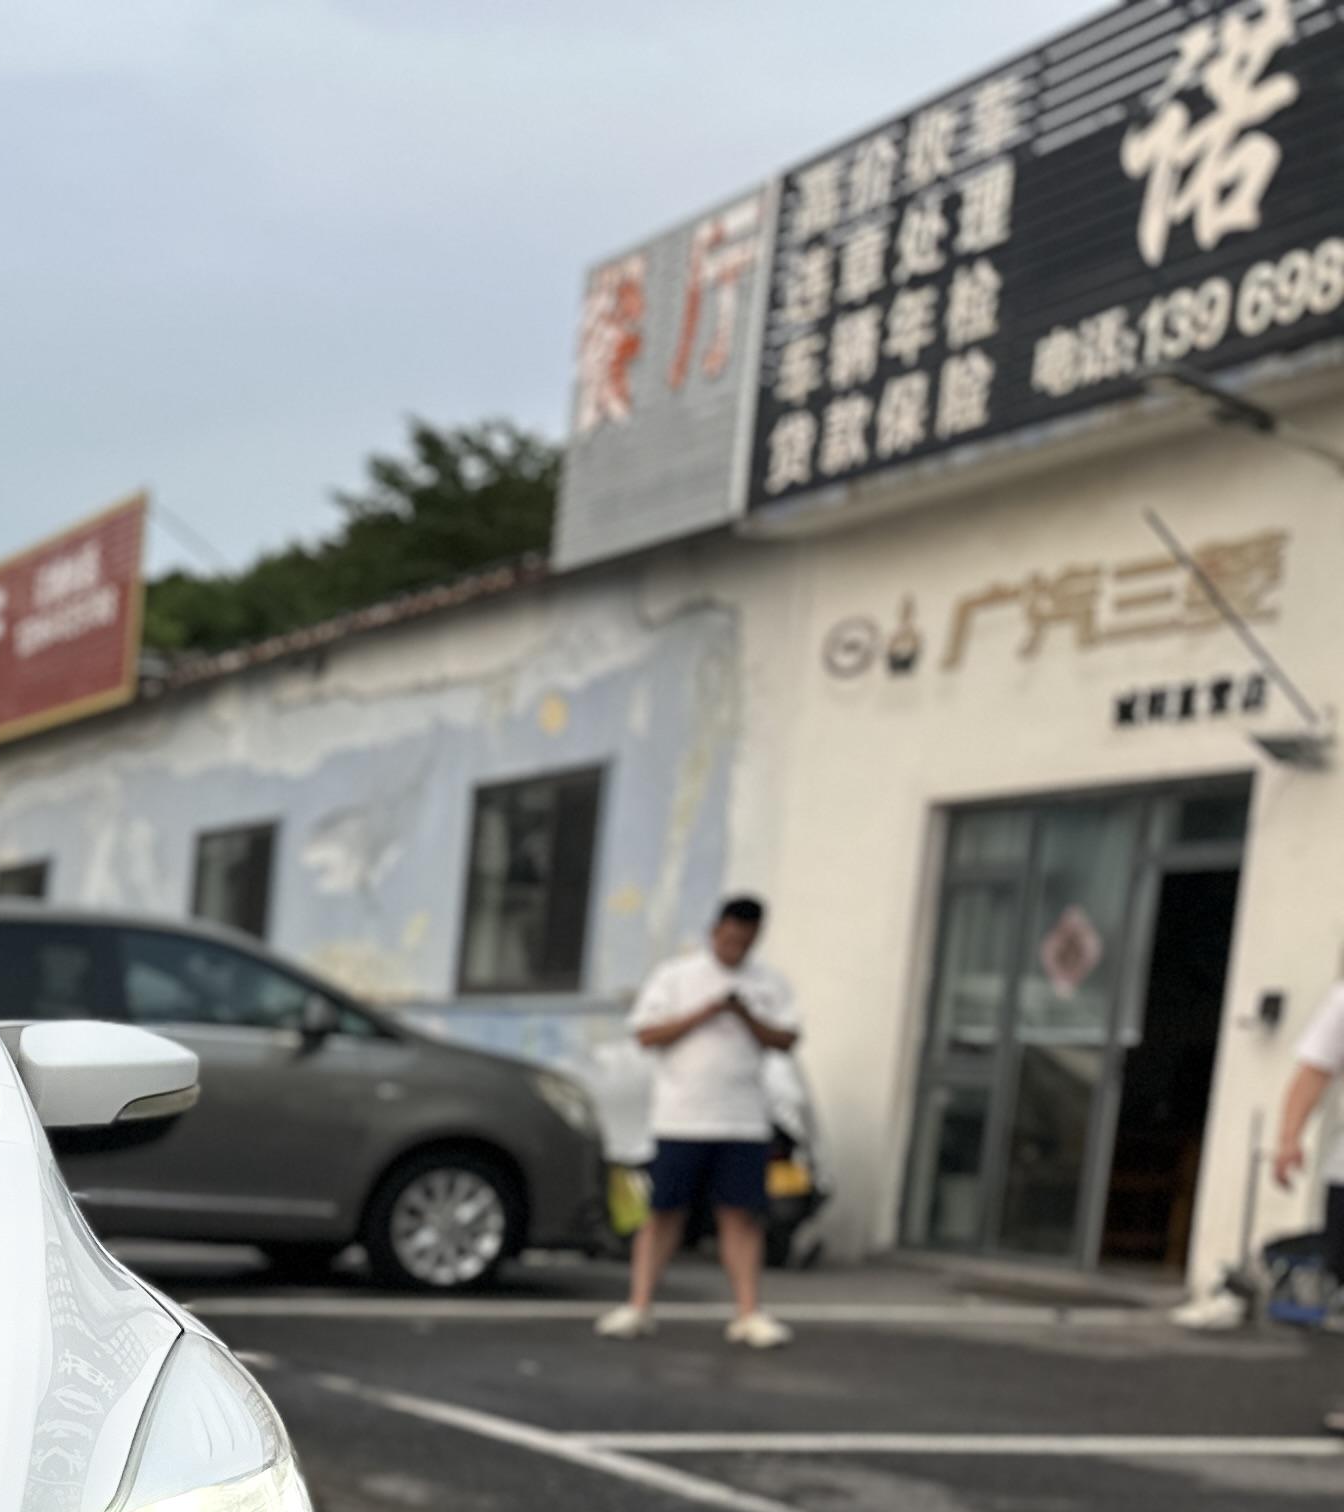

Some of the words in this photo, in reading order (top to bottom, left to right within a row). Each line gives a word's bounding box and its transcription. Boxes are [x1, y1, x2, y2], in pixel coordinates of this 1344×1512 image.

[770, 158, 1015, 326] 违章处理
[770, 258, 1002, 406] 车辆年检
[764, 345, 996, 496] 贷款保险
